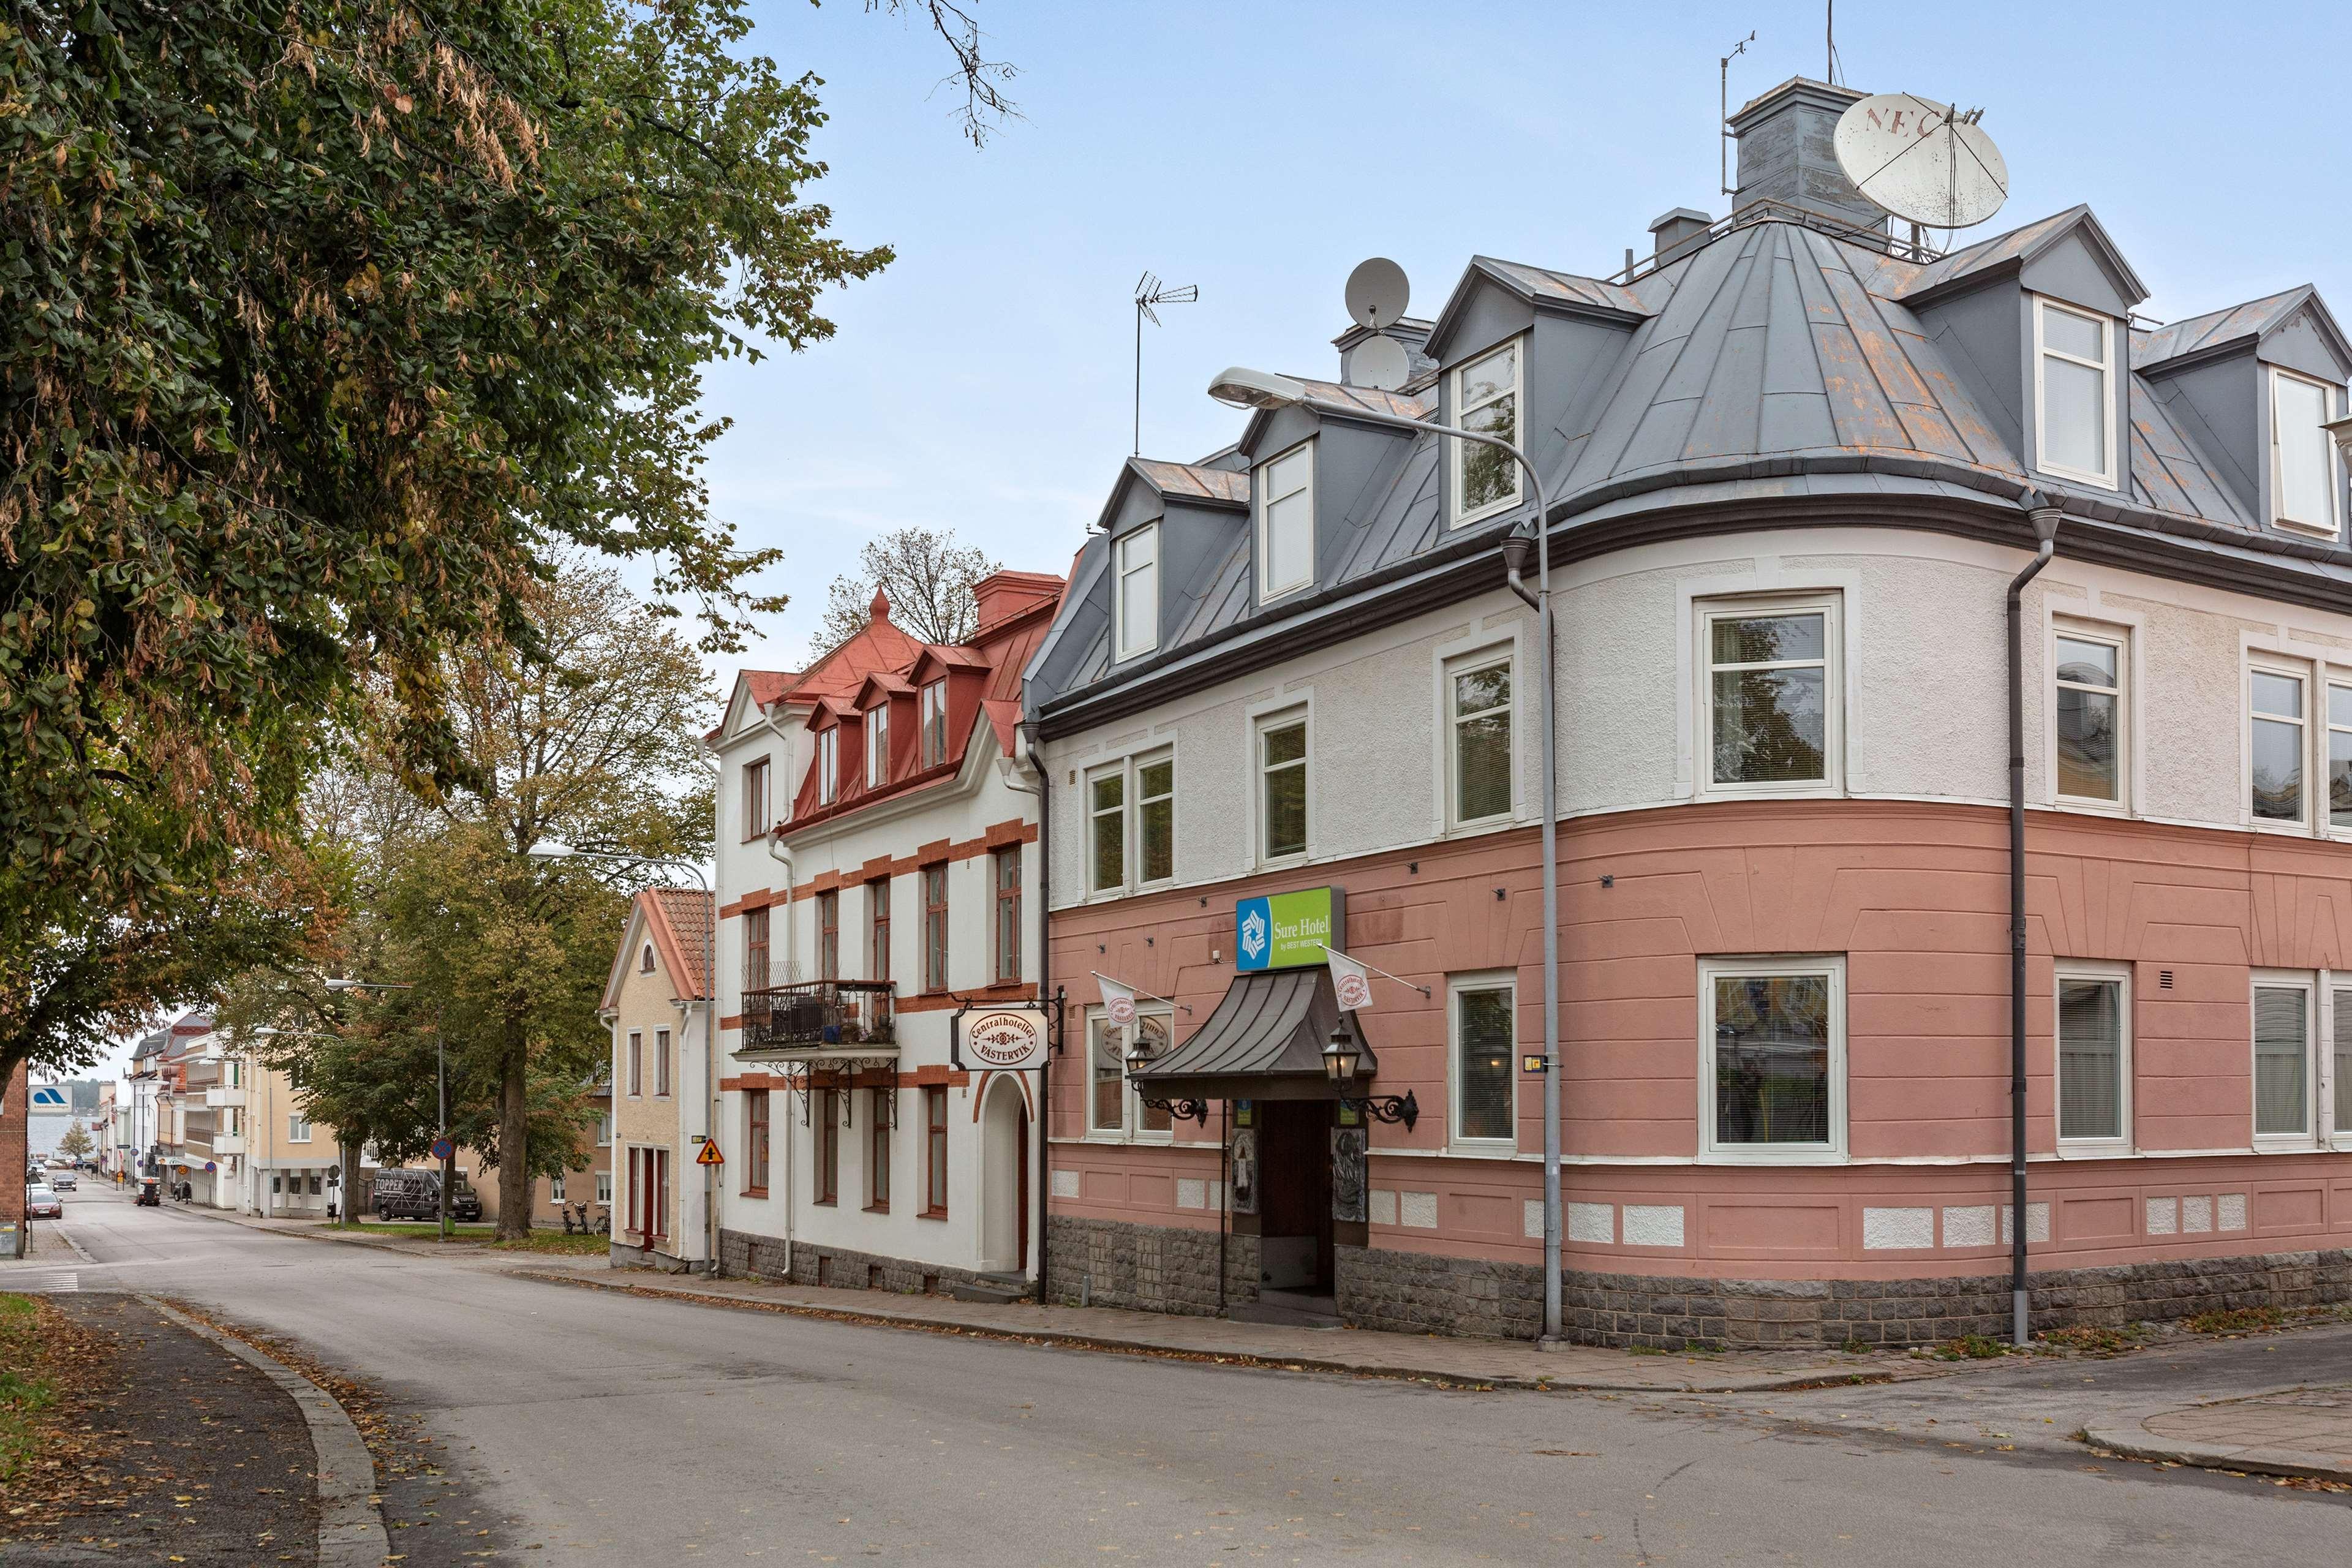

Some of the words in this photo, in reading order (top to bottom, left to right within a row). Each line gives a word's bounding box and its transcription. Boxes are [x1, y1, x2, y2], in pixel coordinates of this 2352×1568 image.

[1866, 107, 1941, 138] NEC
[1274, 922, 1298, 940] Sure
[1300, 914, 1329, 936] Hotel
[1280, 943, 1286, 952] by
[1287, 941, 1299, 949] BEST
[1300, 938, 1323, 949] WESTERN
[971, 1017, 1035, 1039] Centralhotellet
[980, 1044, 1030, 1060] VÄSTERVIK
[375, 1178, 404, 1191] TOPPER
